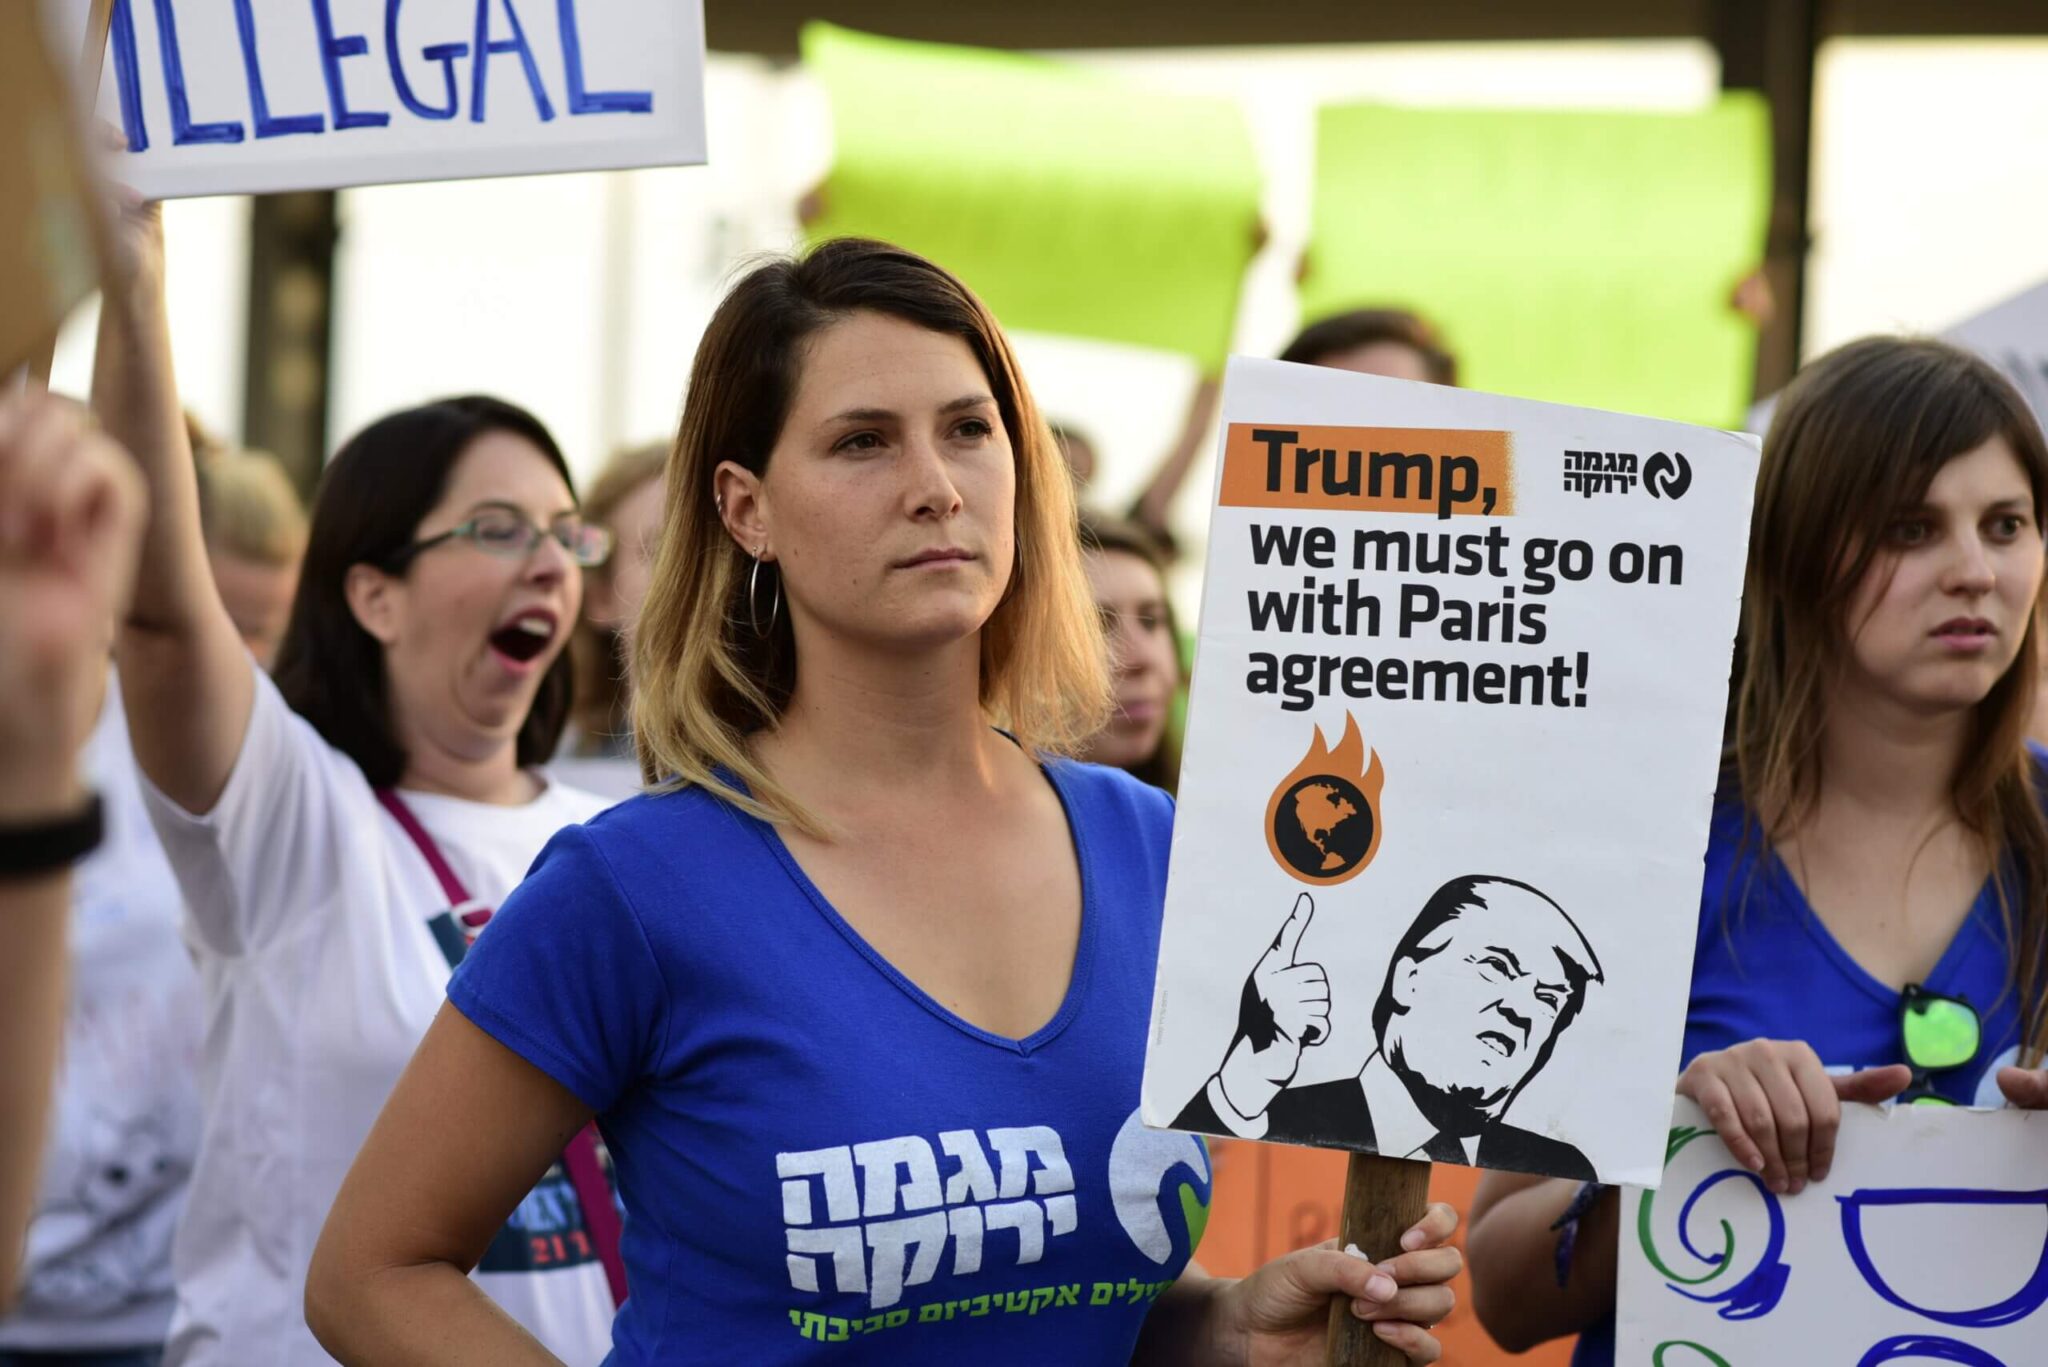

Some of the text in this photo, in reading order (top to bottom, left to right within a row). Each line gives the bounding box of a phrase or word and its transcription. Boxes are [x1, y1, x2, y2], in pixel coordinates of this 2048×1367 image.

[111, 0, 654, 153] ILLEGAL
[1252, 428, 1498, 520] Trump,
[1563, 472, 1638, 499] ירוקה
[1564, 450, 1638, 473] מגמה
[1249, 524, 1684, 595] we must go on
[1247, 575, 1548, 645] with Paris
[1246, 651, 1590, 712] agreement!
[775, 1125, 1076, 1226] מגמה
[784, 1194, 1079, 1310] ירוקה
[788, 1308, 910, 1342] סביבתי
[918, 1283, 1081, 1323] אקטיביזם
